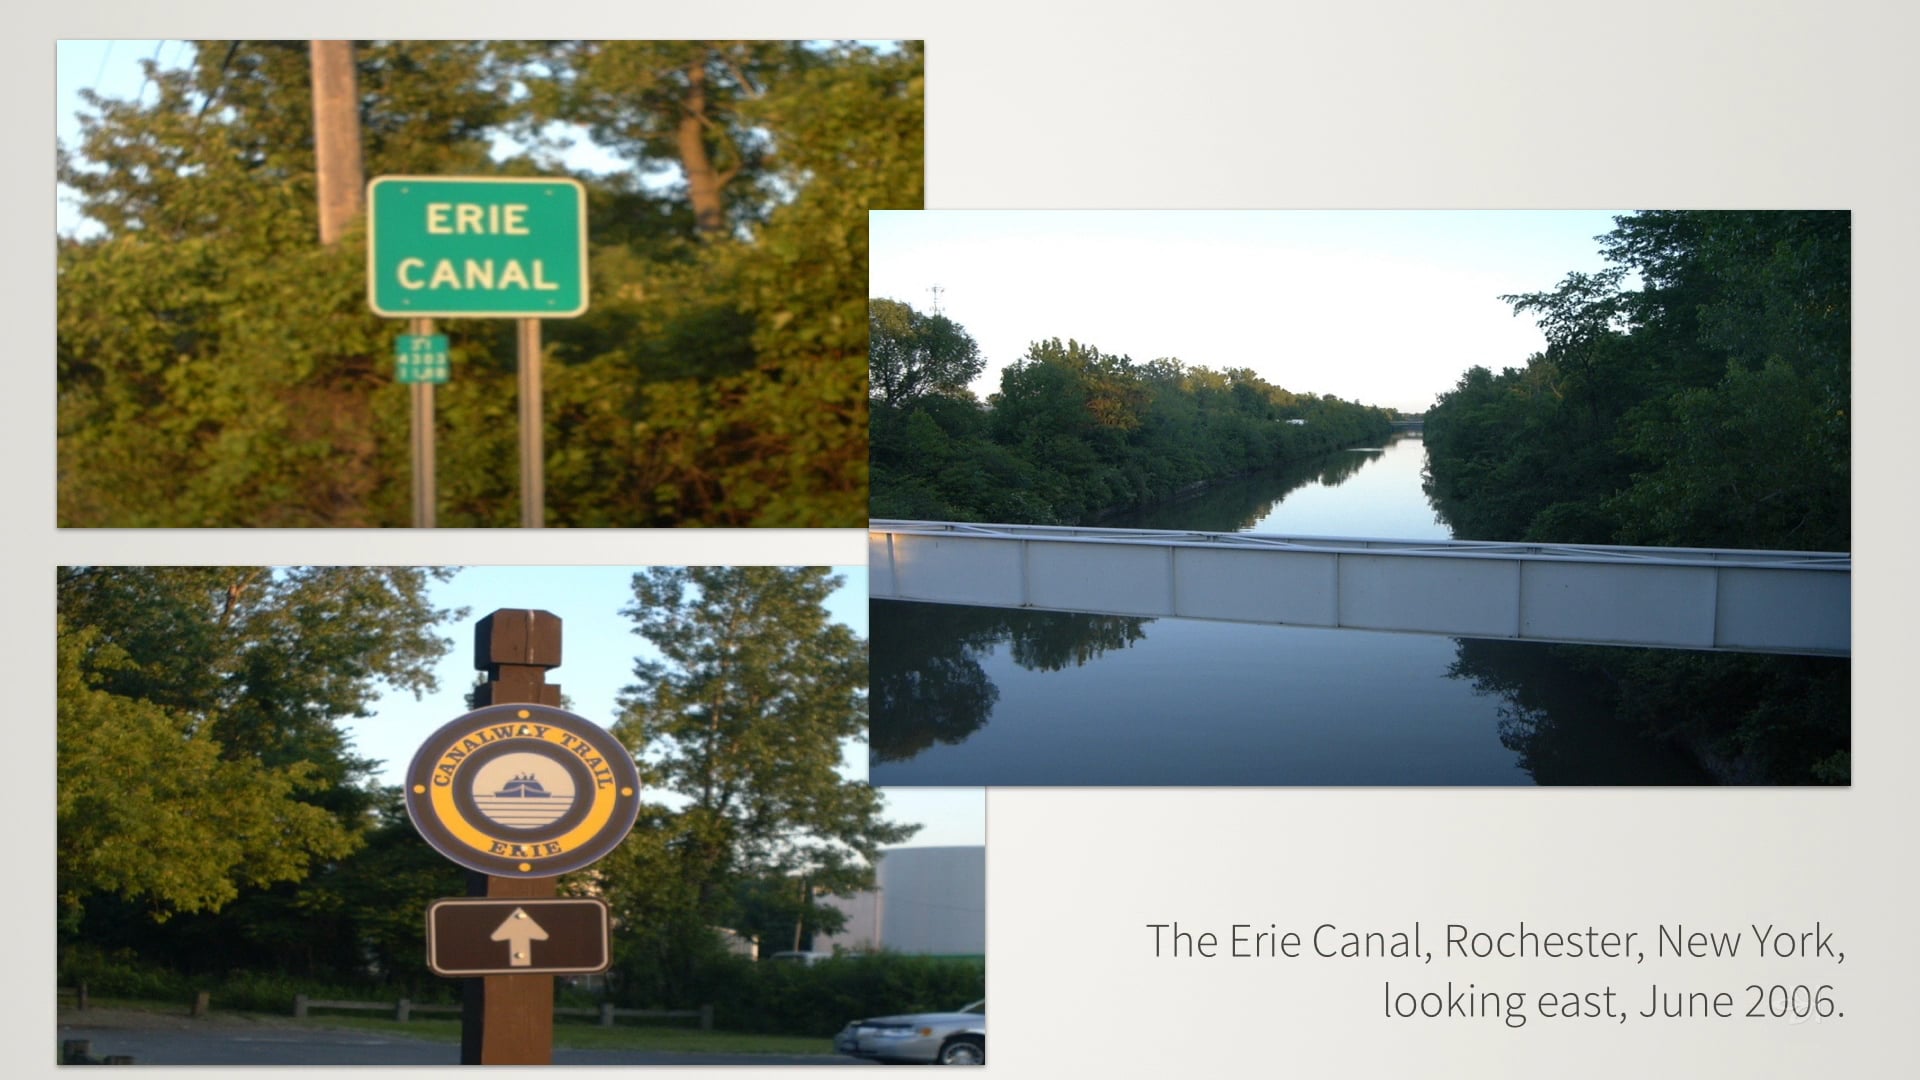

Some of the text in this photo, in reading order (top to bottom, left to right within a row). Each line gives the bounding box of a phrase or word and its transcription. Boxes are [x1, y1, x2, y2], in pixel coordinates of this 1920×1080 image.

[427, 203, 530, 235] ERIE
[397, 257, 560, 290] CANAL
[433, 724, 614, 790] CANALWAY TRAIL
[487, 840, 563, 858] ERIE
